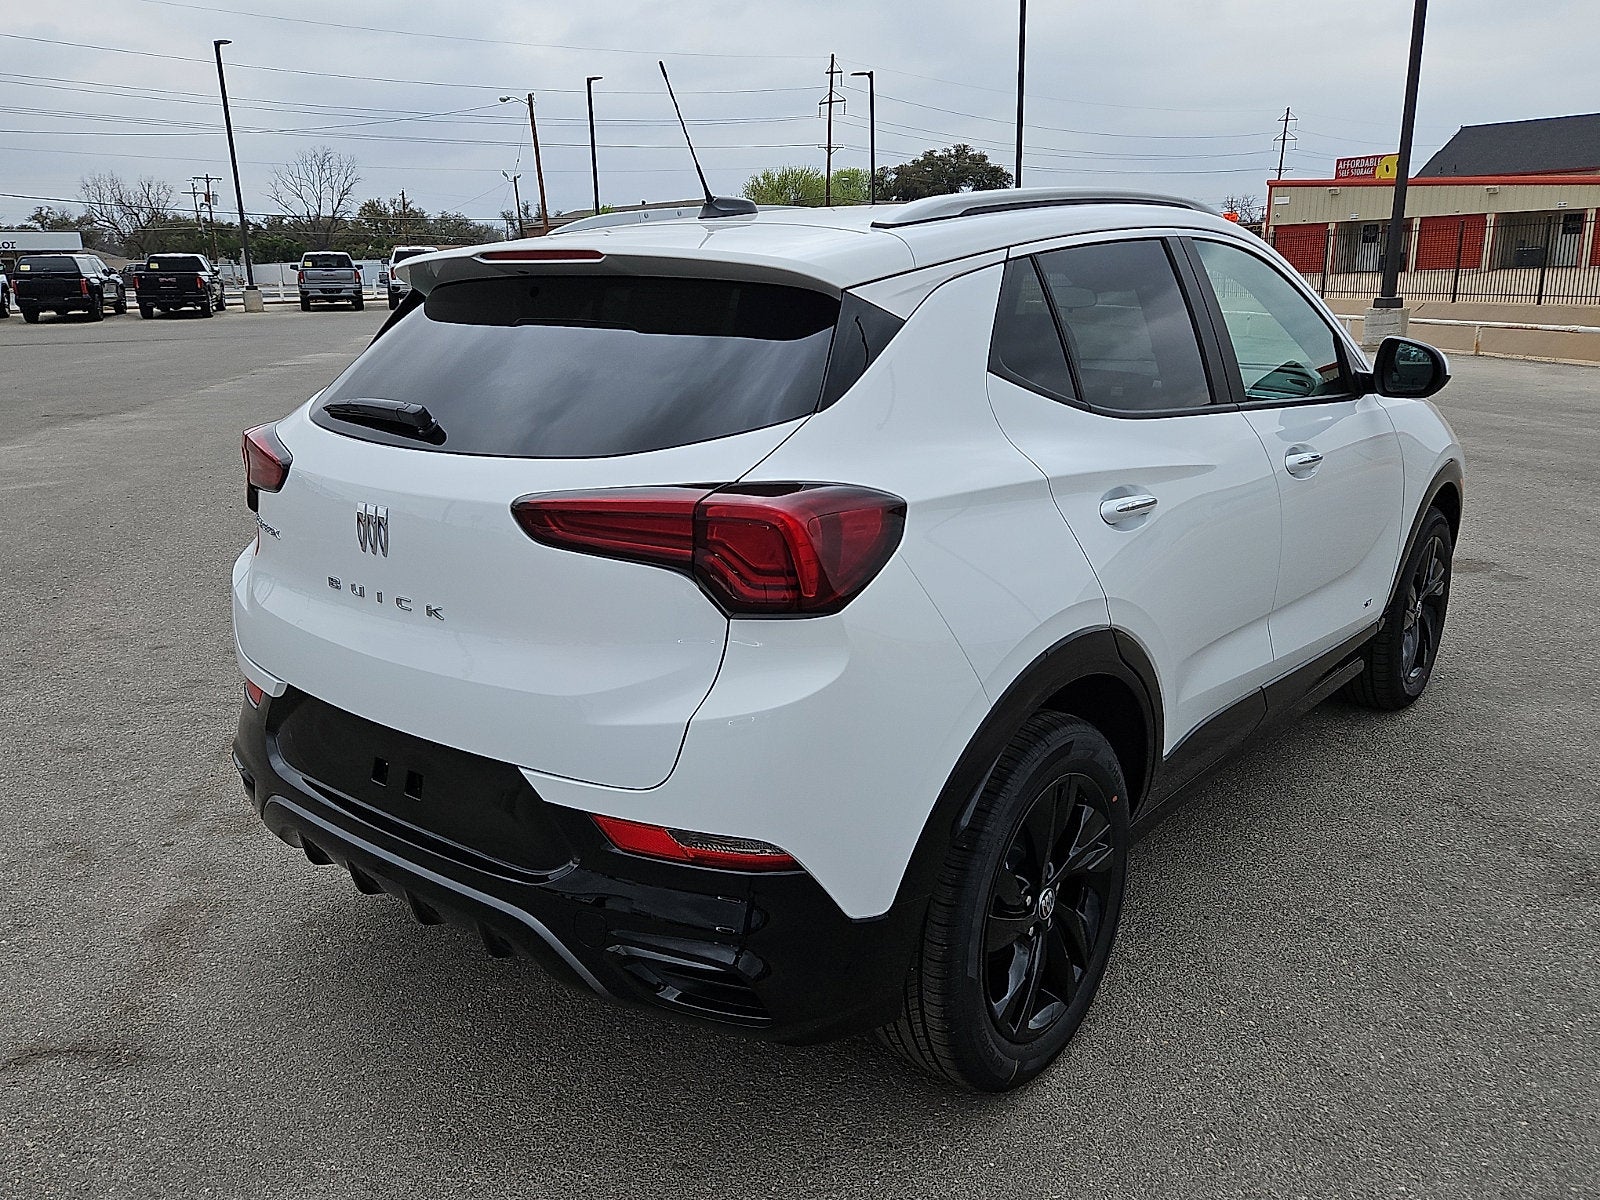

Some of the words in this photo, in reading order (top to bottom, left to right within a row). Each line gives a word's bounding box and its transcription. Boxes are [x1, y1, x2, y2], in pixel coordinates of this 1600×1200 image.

[1338, 157, 1381, 169] AFFORDABLE
[1338, 169, 1350, 177] SELF
[1351, 167, 1374, 176] STORAGE
[327, 575, 445, 621] BUICK
